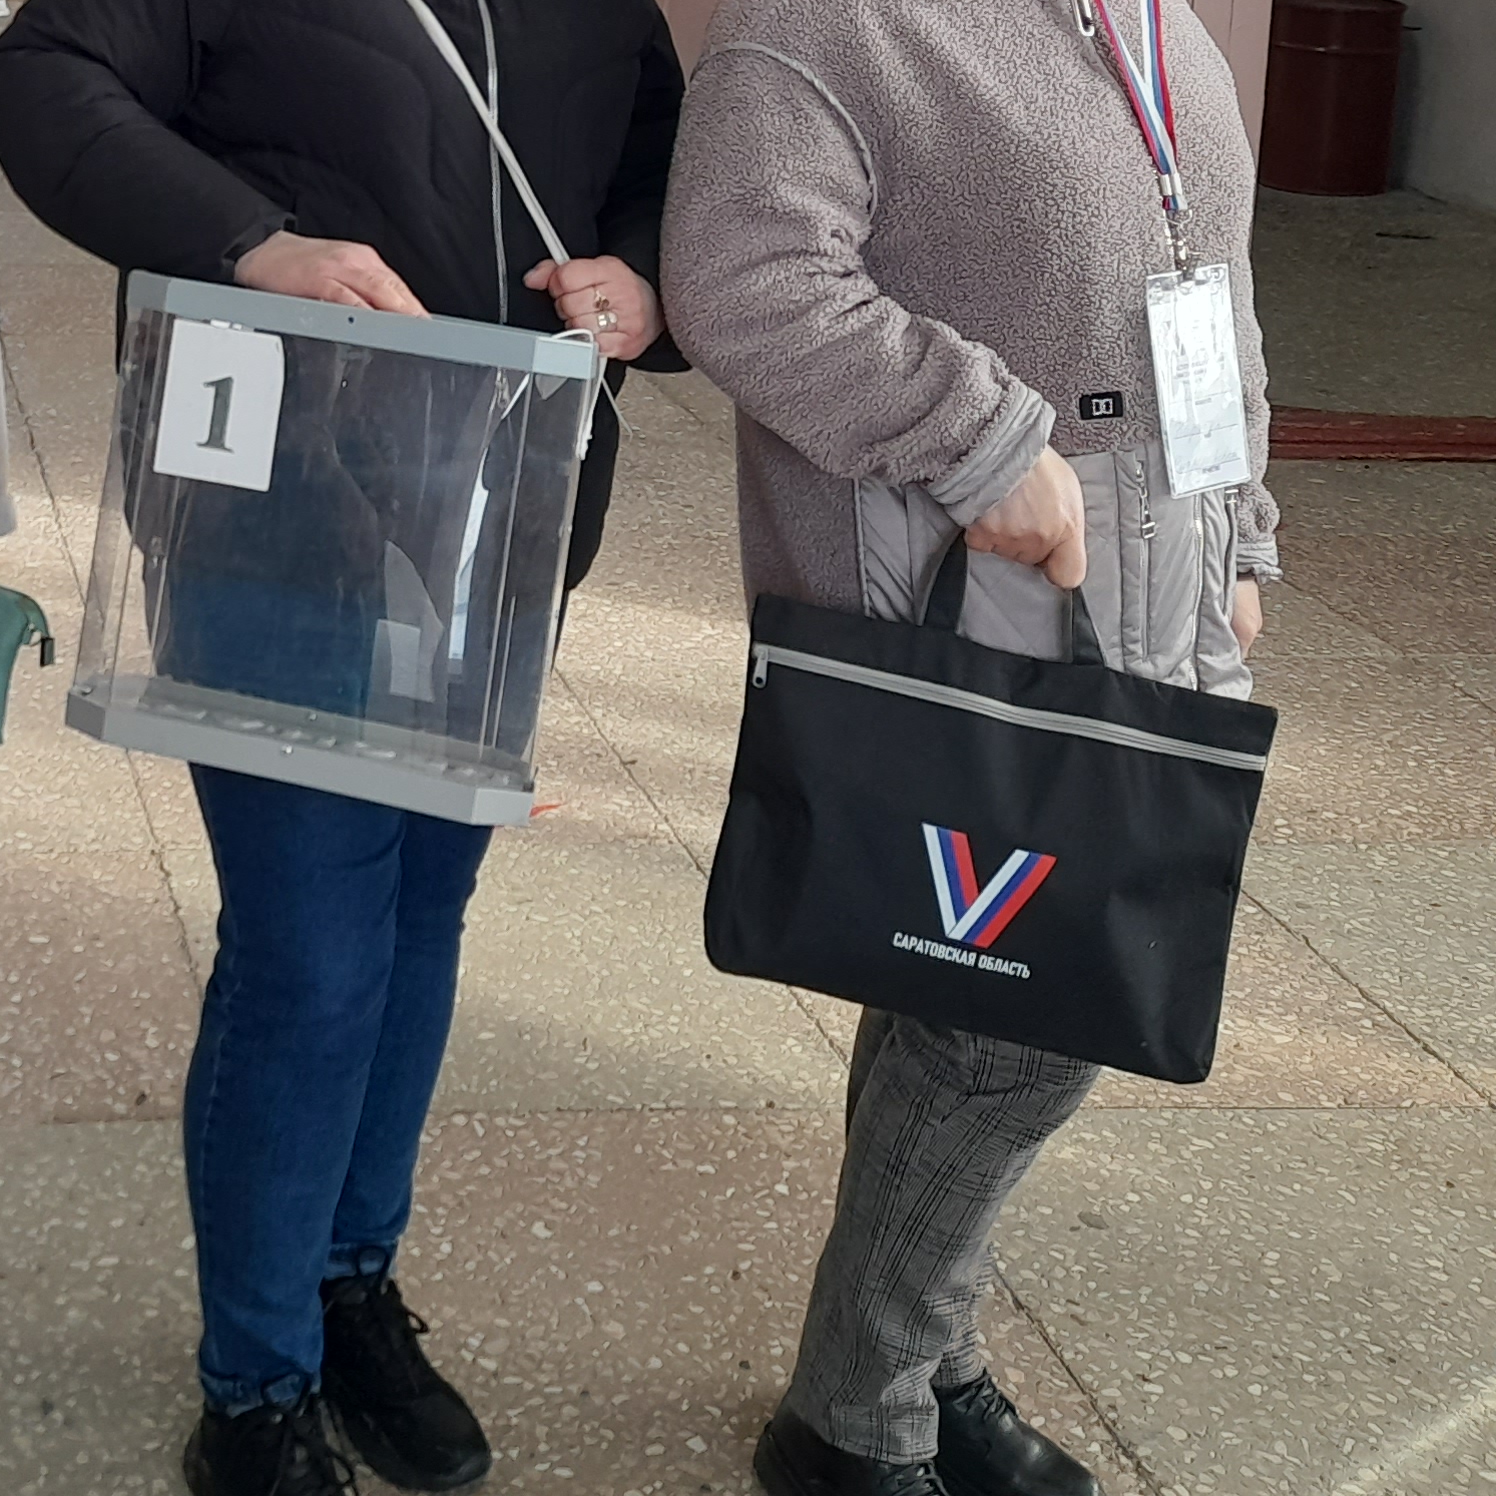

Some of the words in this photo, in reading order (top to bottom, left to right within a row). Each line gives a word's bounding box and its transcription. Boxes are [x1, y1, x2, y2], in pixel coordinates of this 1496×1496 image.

[195, 376, 235, 454] 1
[892, 932, 977, 967] САРАТОВСКАЯ
[978, 955, 1031, 979] ОБЛАСТЬ
